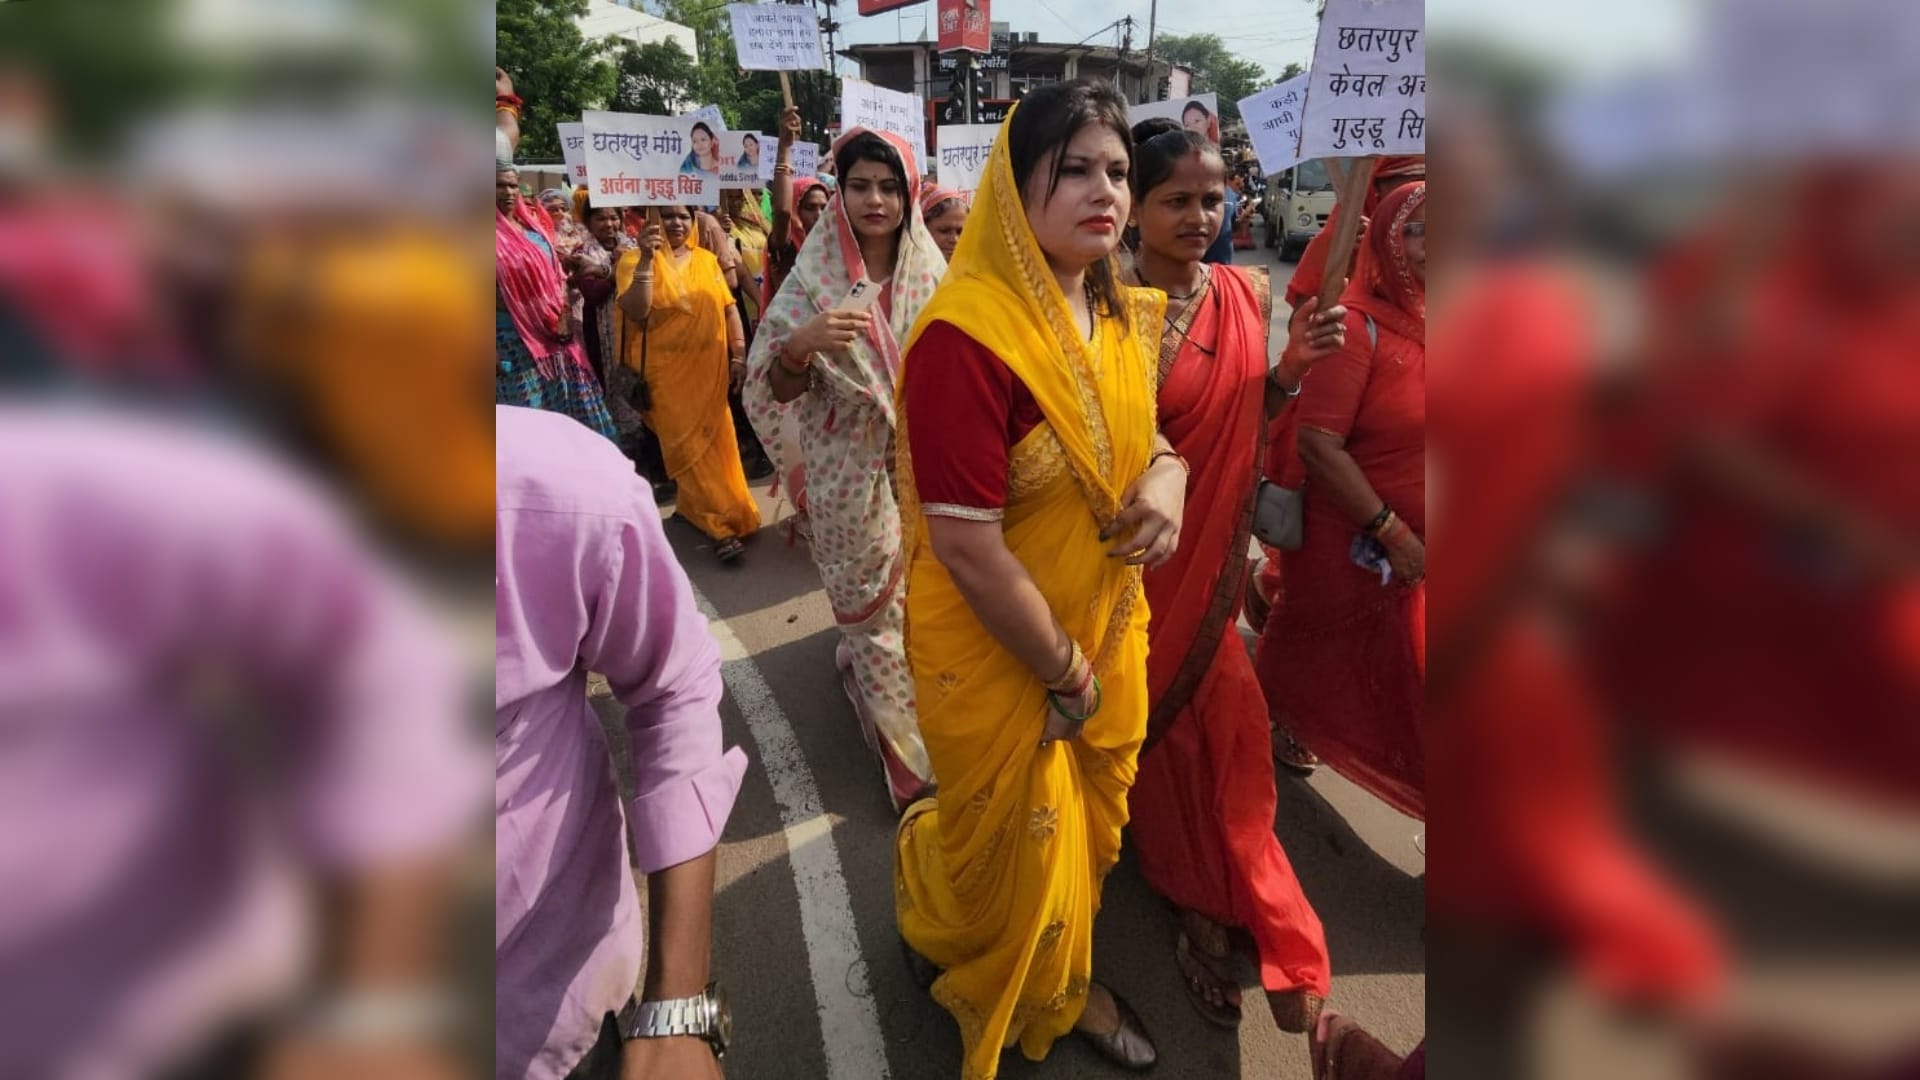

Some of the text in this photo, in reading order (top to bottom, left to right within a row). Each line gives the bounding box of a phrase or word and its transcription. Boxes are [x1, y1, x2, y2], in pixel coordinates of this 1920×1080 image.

[1338, 27, 1419, 63] छतरपुर
[1329, 63, 1389, 97] केवल
[593, 130, 683, 160] छतरपुर मांगे
[942, 144, 979, 171] छतरपुर
[600, 171, 641, 195] अर्चना
[677, 174, 704, 195] सिंह
